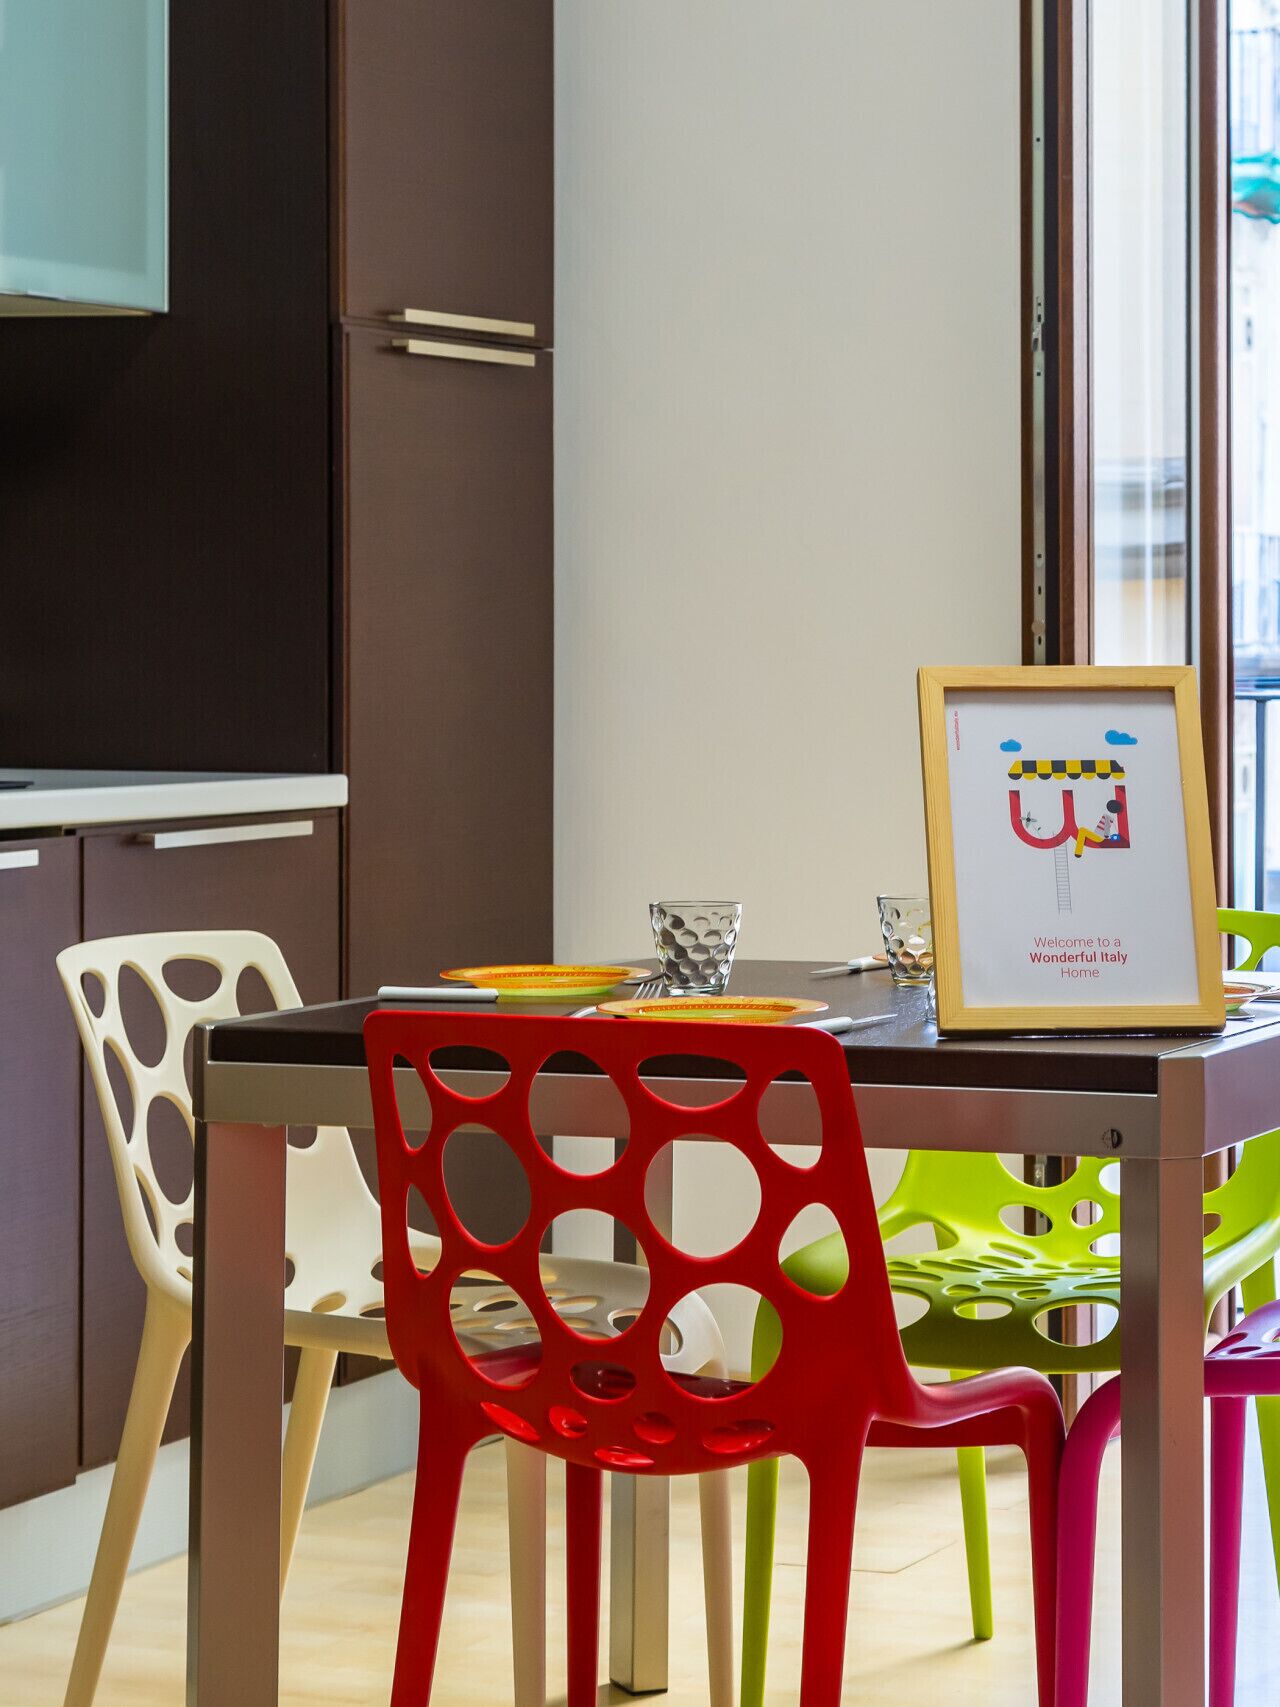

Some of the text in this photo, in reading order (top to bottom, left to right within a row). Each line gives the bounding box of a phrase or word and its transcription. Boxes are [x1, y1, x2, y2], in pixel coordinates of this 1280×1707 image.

[1034, 936, 1121, 948] Welcome to a
[1030, 951, 1128, 965] Wonderful Italy
[1061, 967, 1100, 979] Home
